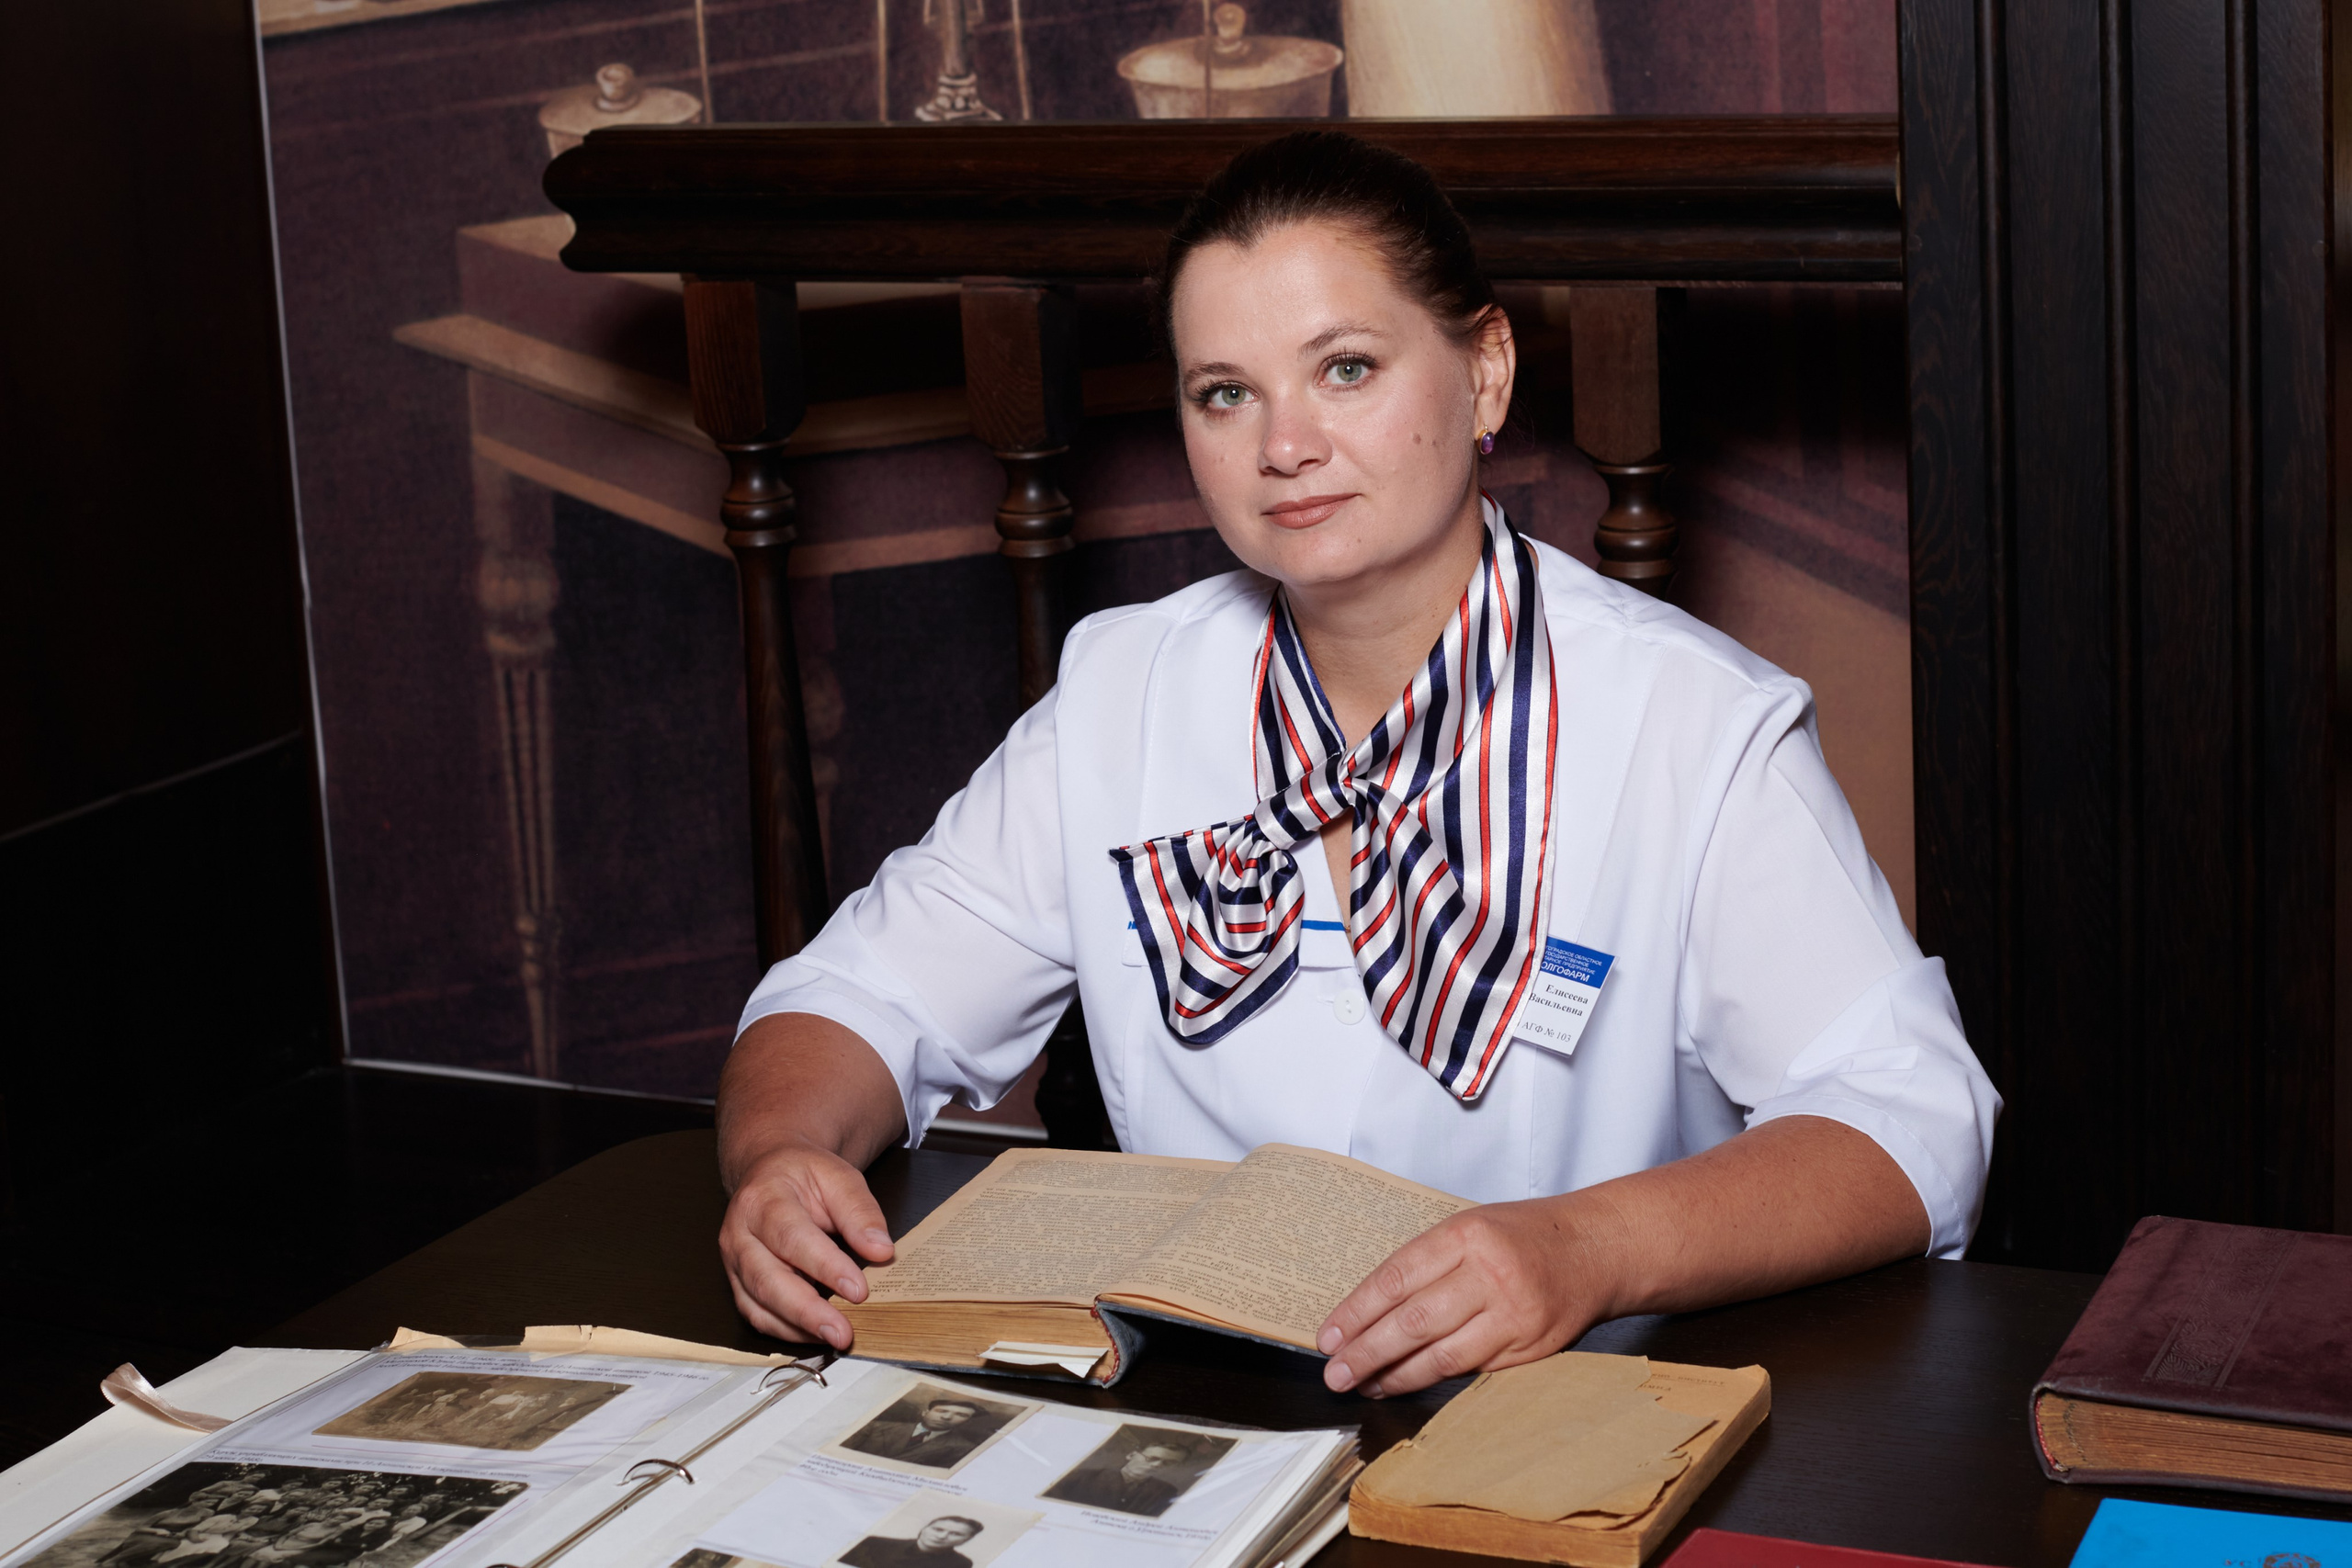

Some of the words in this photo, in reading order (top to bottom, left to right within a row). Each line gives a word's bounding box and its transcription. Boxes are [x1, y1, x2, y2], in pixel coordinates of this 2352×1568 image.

[1541, 961, 1590, 982] ОЛГОФАРМ
[1529, 992, 1583, 1017] Васильевна
[1545, 984, 1589, 1005] Елисеева
[1521, 1021, 1543, 1033] АГФ
[1544, 1028, 1555, 1038] №
[1556, 1032, 1572, 1043] 103
